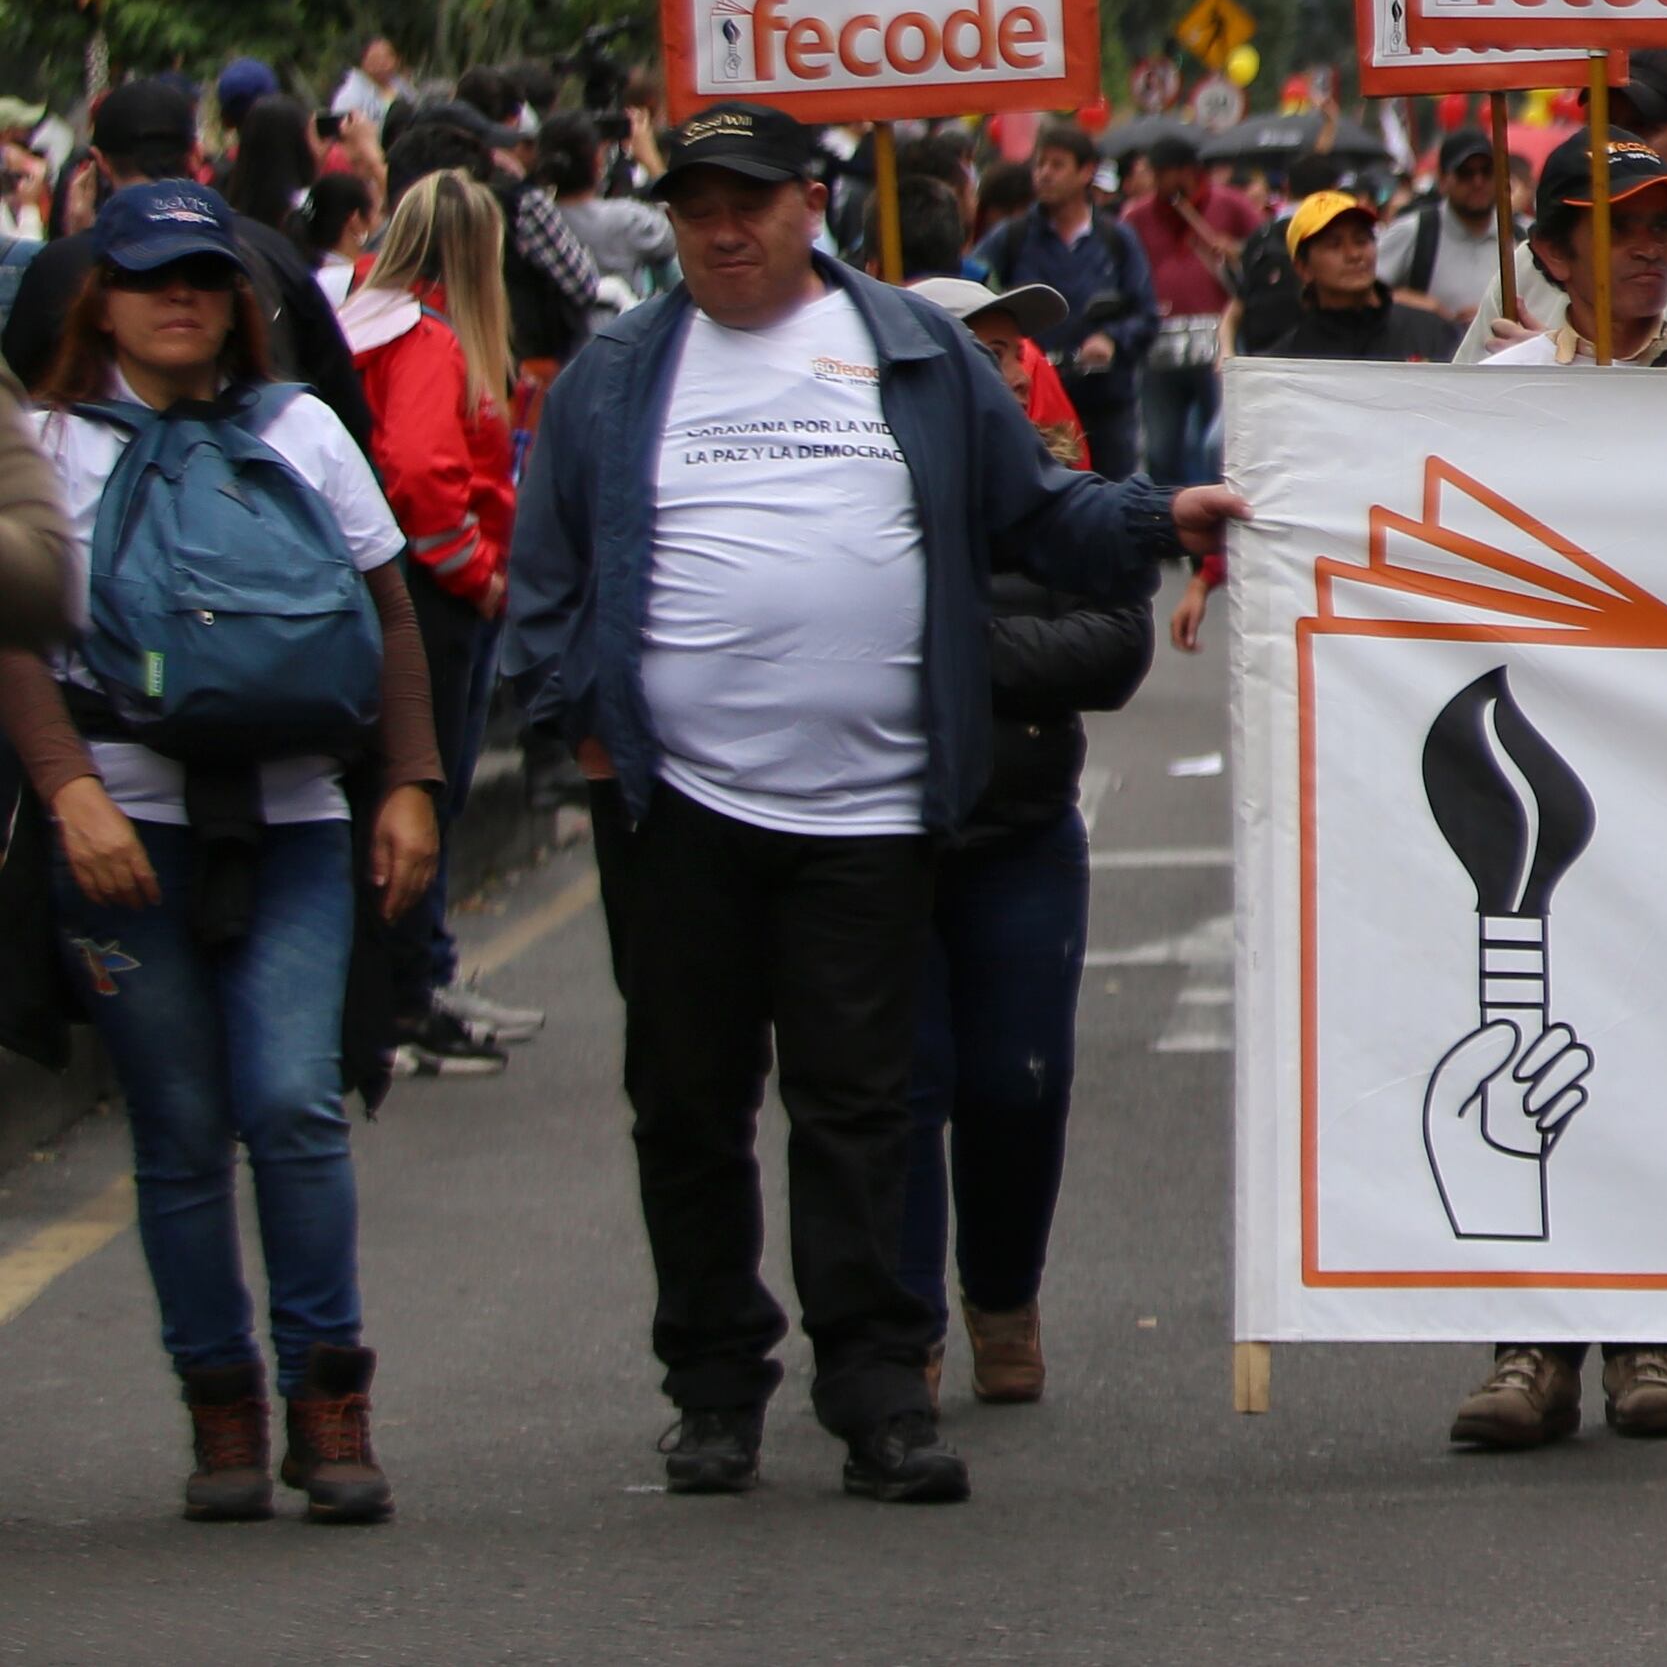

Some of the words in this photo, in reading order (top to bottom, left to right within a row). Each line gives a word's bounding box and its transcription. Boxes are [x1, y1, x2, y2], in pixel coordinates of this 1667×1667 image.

[838, 361, 880, 379] feco
[793, 420, 831, 434] POR
[836, 420, 860, 434] LA
[862, 421, 893, 435] VID
[685, 451, 708, 465] LA
[713, 448, 749, 463] PAZ
[752, 447, 764, 461] Y
[769, 446, 793, 460] LA
[798, 444, 904, 463] DEMOCRAC
